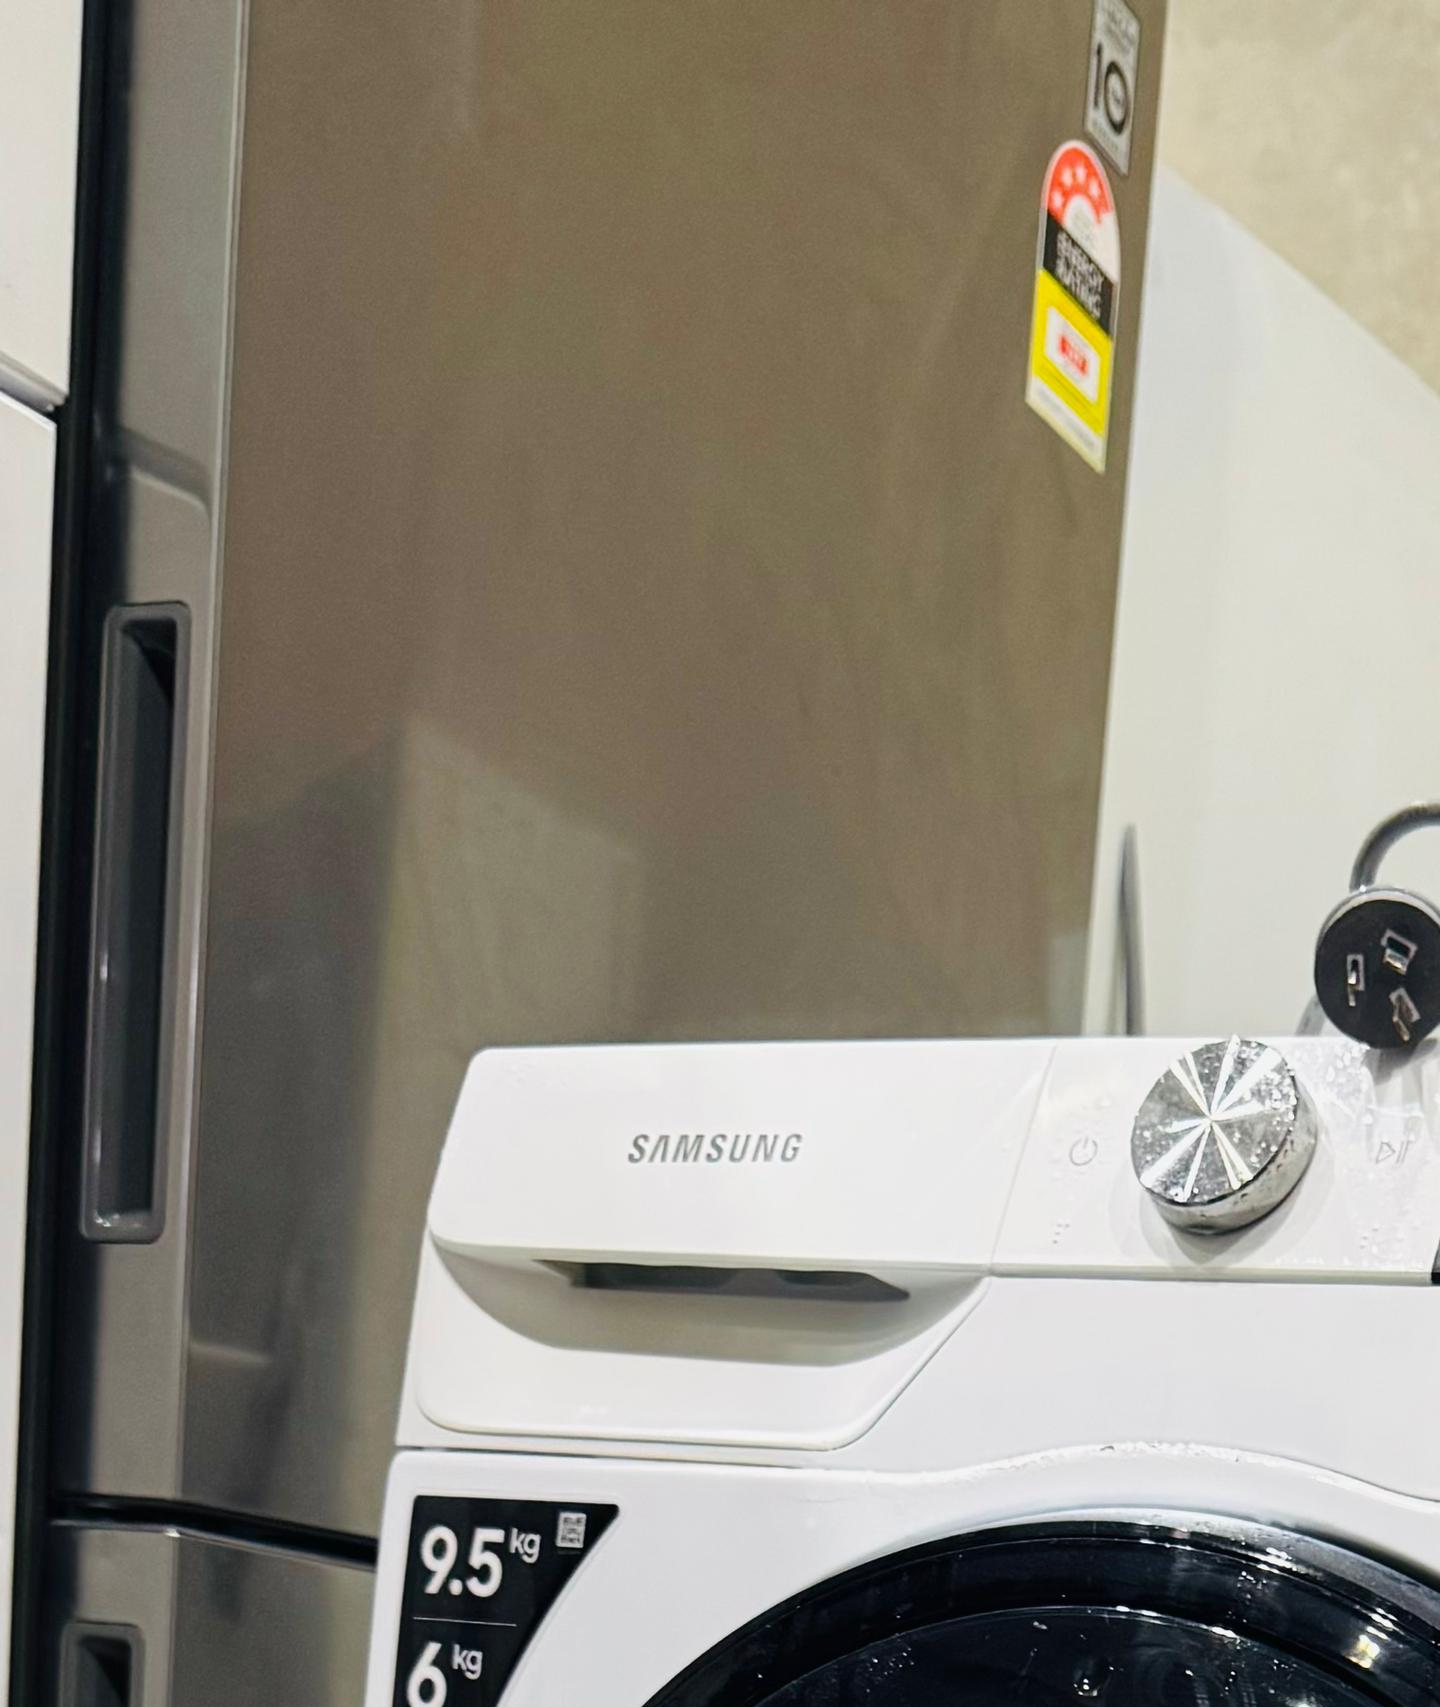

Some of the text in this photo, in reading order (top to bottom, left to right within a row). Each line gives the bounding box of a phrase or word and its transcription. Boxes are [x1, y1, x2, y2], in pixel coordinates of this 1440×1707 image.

[628, 1133, 803, 1164] SAMSUNG
[420, 1525, 542, 1598] 9.5 kg
[452, 1643, 483, 1681] kg
